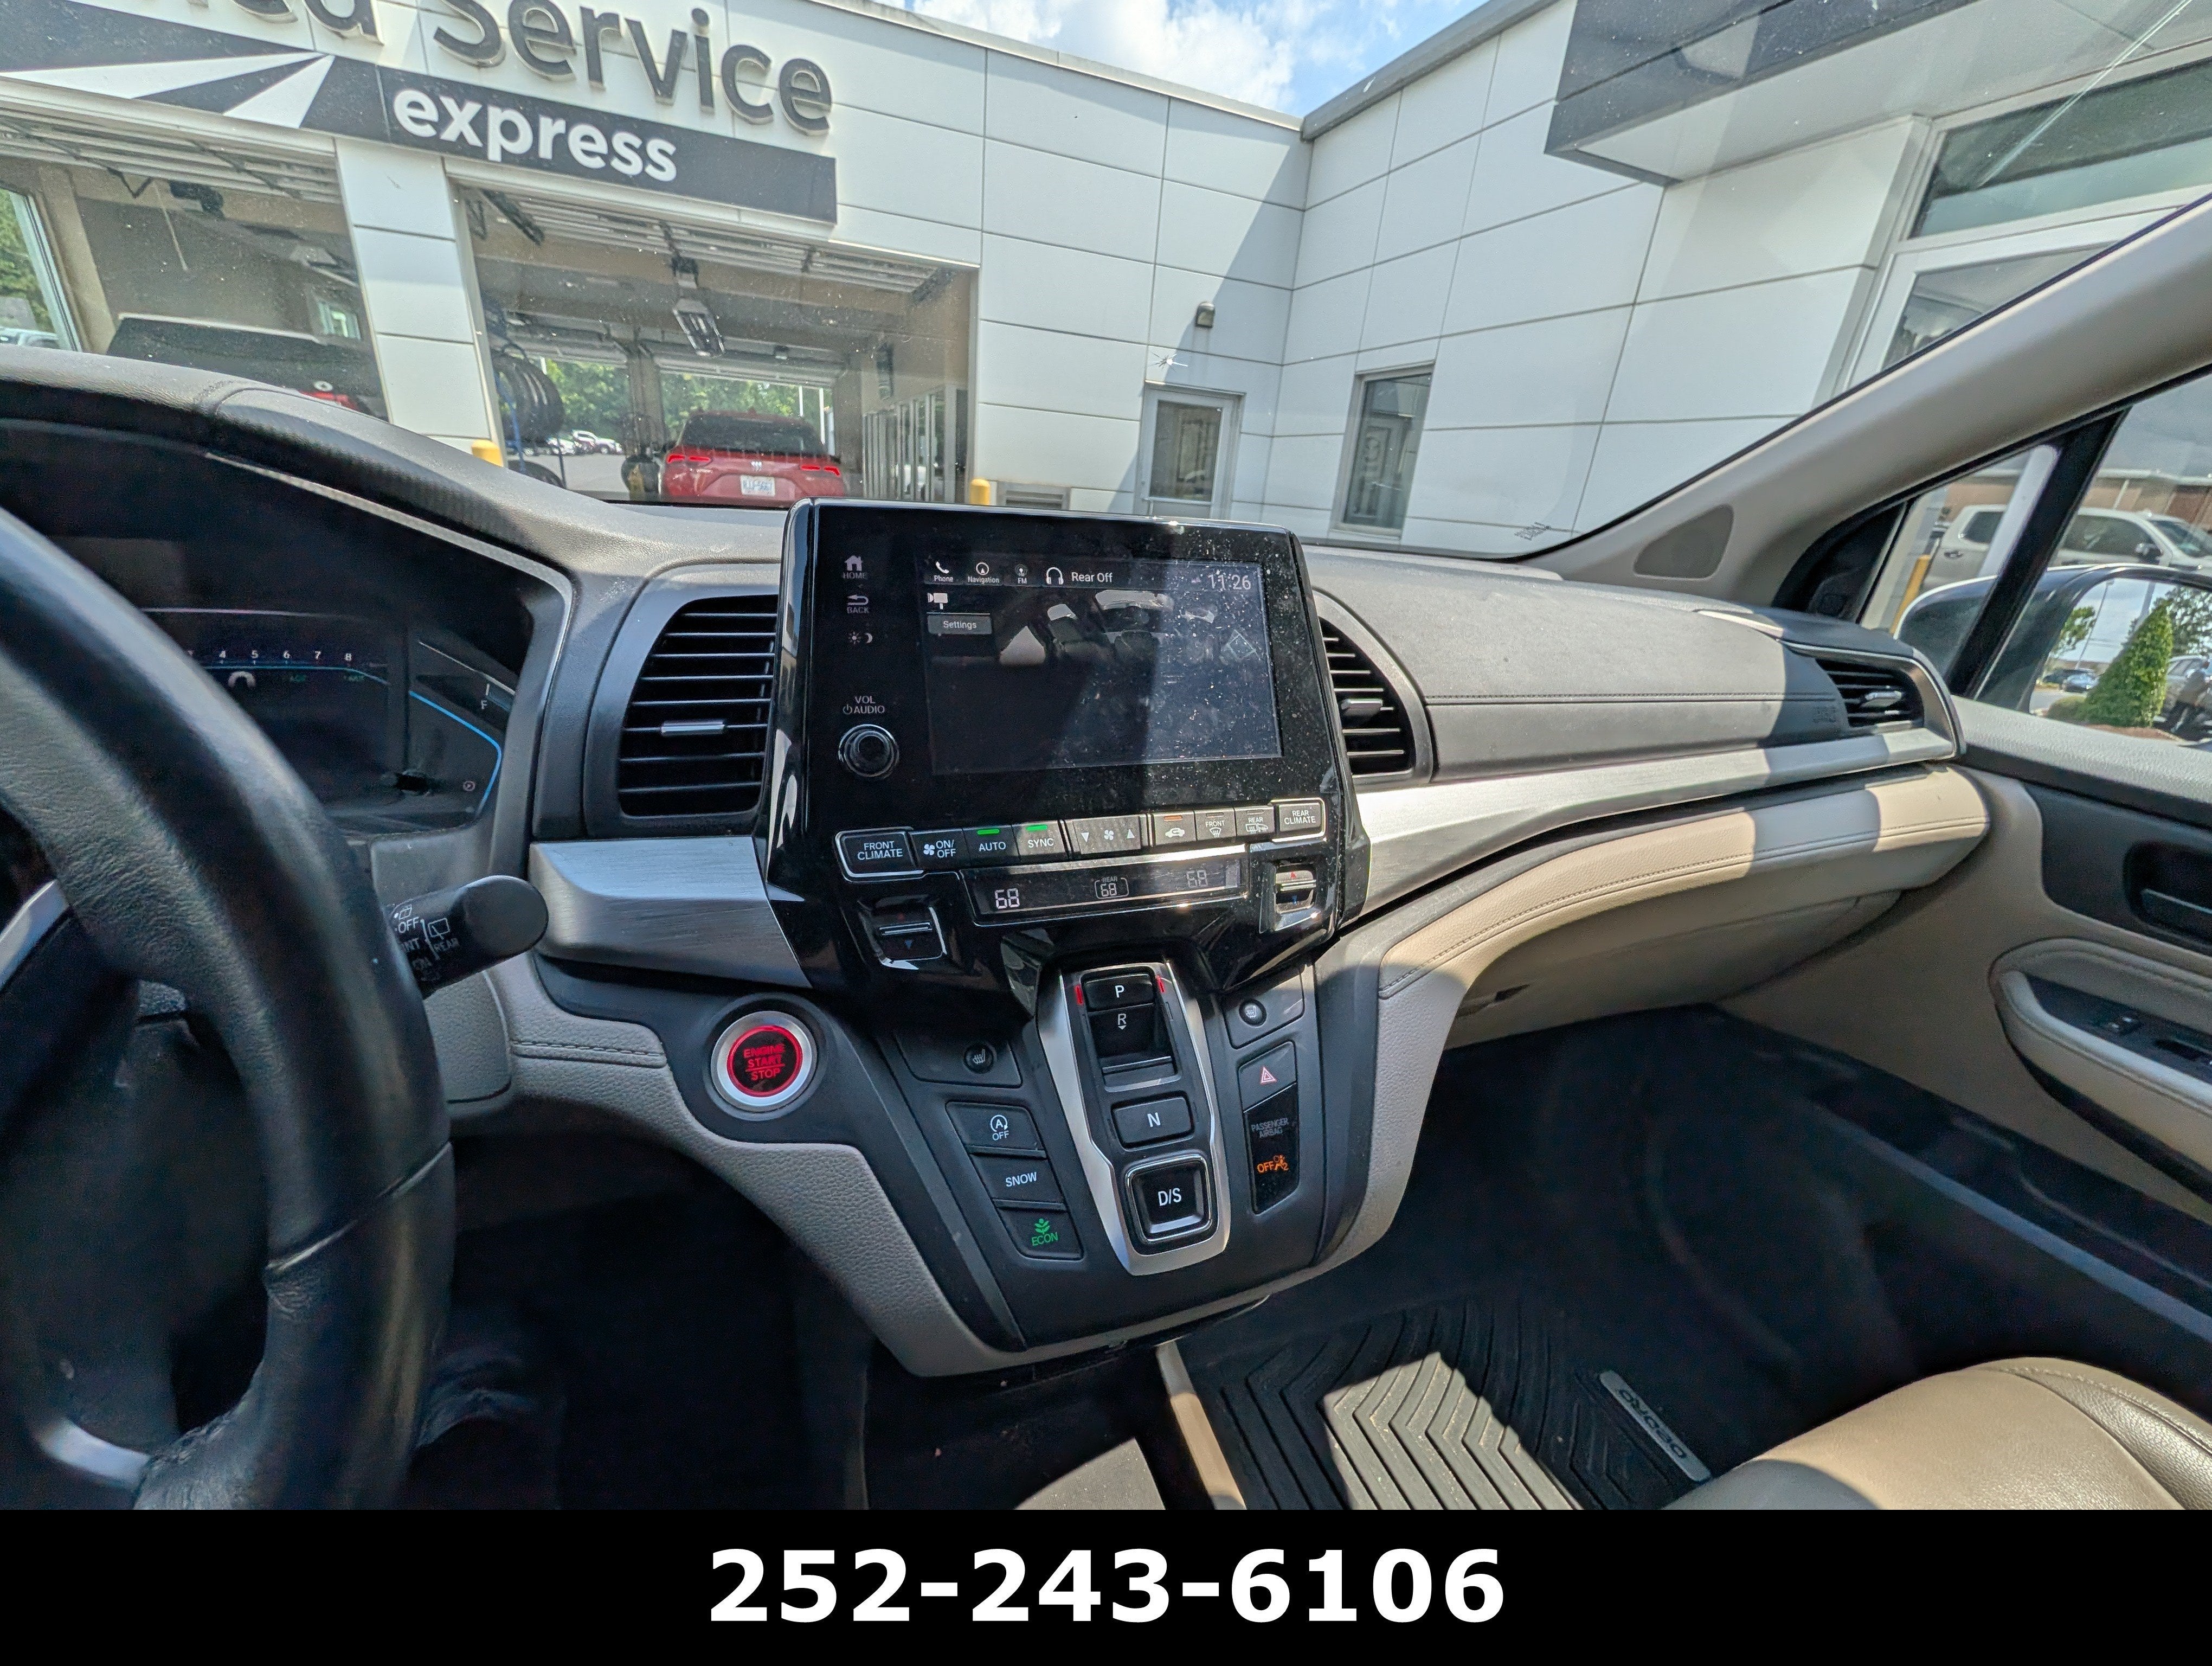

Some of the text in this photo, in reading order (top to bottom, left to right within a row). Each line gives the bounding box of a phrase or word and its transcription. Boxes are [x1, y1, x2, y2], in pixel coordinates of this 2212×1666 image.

[434, 0, 833, 136] Service
[393, 89, 677, 182] express
[843, 571, 868, 580] HOME
[934, 574, 954, 582] Phone
[967, 575, 1000, 584] Navigation
[1071, 572, 1113, 583] Rear Off
[1208, 574, 1251, 591] 11:26
[943, 620, 977, 630] Settings
[218, 650, 226, 658] 4
[251, 650, 259, 658] 5
[283, 650, 291, 659] 6
[314, 650, 321, 659] 7
[345, 653, 352, 661] 8
[480, 700, 487, 709] F
[854, 695, 876, 704] VOL
[854, 704, 885, 714] AUDIO
[1284, 816, 1316, 824] CLIMATE
[864, 840, 895, 851] FRONT
[936, 840, 954, 849] ON/
[979, 841, 1006, 852] AUTO
[1027, 838, 1054, 848] SYNC
[857, 848, 903, 861] CLIMATE
[937, 847, 956, 858] OFF
[1186, 869, 1208, 888] 68
[1099, 883, 1117, 897] 68
[995, 888, 1019, 909] 68
[398, 917, 420, 933] OFF
[1115, 985, 1125, 998] P
[1117, 1013, 1127, 1026] R
[743, 1043, 786, 1058] ENGINE
[747, 1054, 783, 1067] START
[750, 1068, 781, 1081] STOP
[1148, 1112, 1161, 1128] N
[1251, 1118, 1289, 1132] PASSENGER
[992, 1130, 1009, 1141] OFF
[1258, 1127, 1283, 1139] AIRBAG
[1257, 1161, 1274, 1174] OFF
[1005, 1171, 1038, 1187] SNOW
[1158, 1188, 1182, 1207] D/S
[1031, 1232, 1058, 1247] ECON
